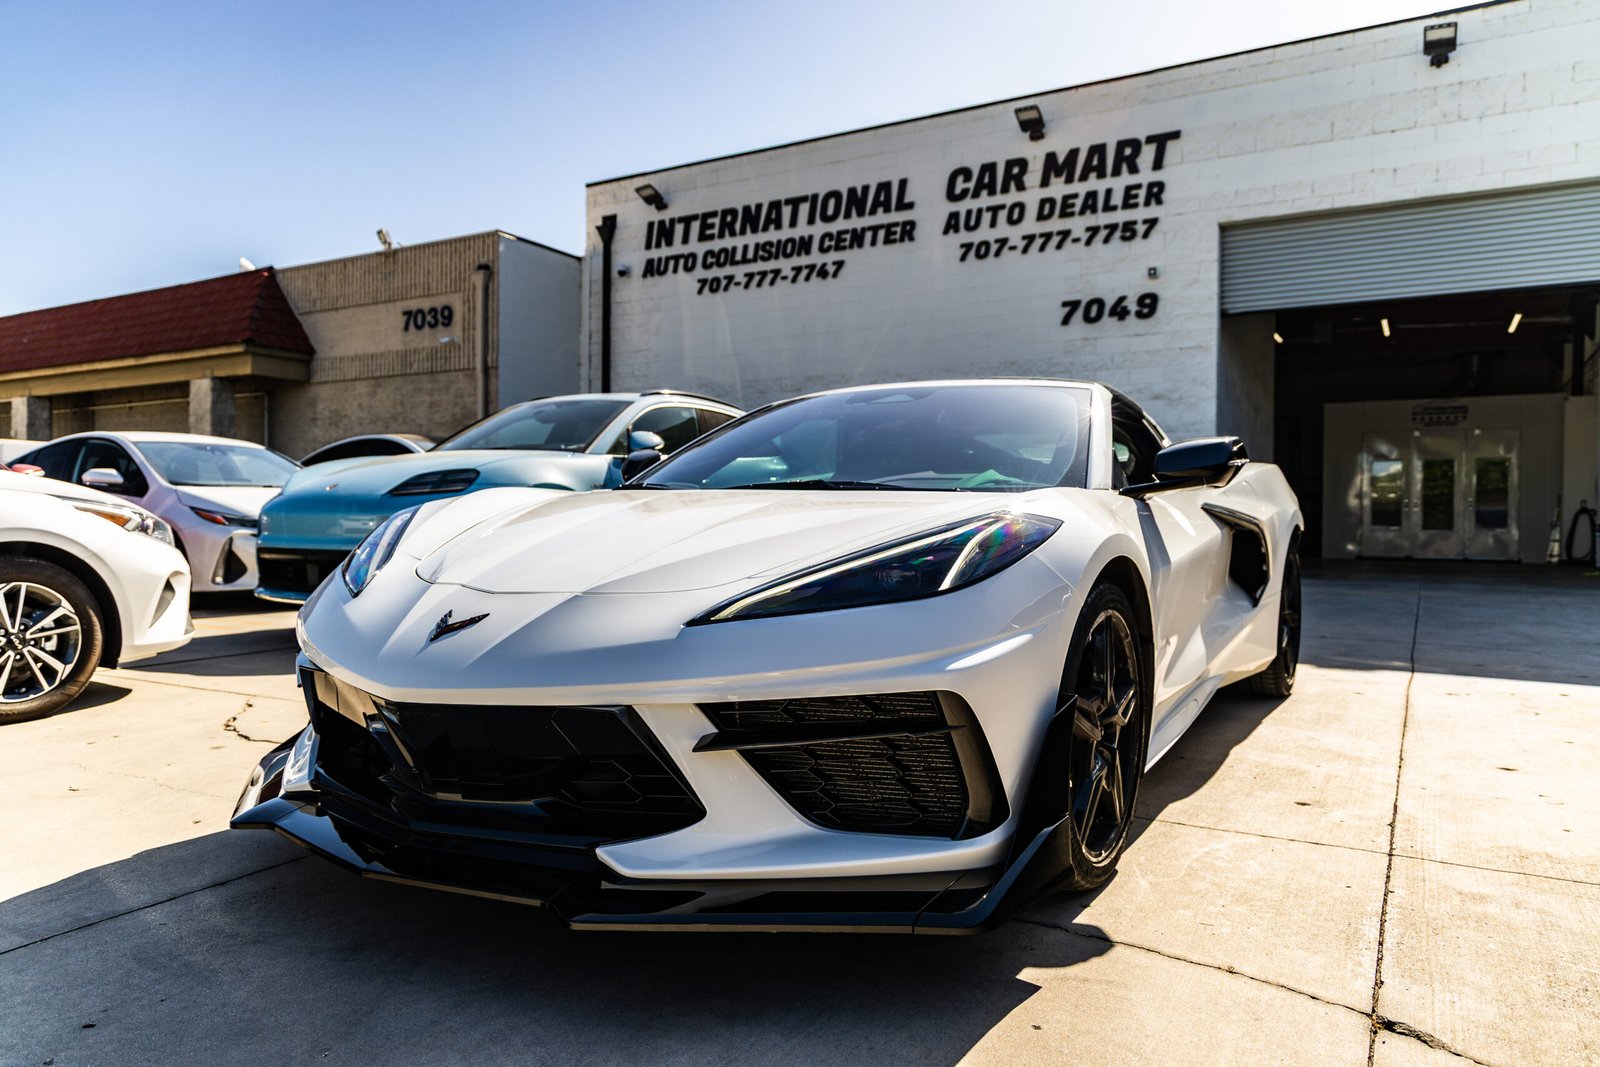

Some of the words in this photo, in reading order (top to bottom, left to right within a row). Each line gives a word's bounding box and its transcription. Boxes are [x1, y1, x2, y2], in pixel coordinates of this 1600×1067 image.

[945, 157, 1029, 203] CAR
[1039, 129, 1182, 189] MART
[644, 177, 916, 251] INTERNATIONAL
[942, 201, 1026, 236] AUTO
[1035, 180, 1166, 222] DEALER
[641, 251, 698, 279] AUTO
[701, 234, 814, 271] COLLISION
[817, 219, 917, 254] CENTER
[958, 217, 1160, 263] 707-777-7757
[696, 259, 846, 296] 707-777-7747
[401, 304, 455, 333] 7039
[1059, 292, 1160, 327] 7049
